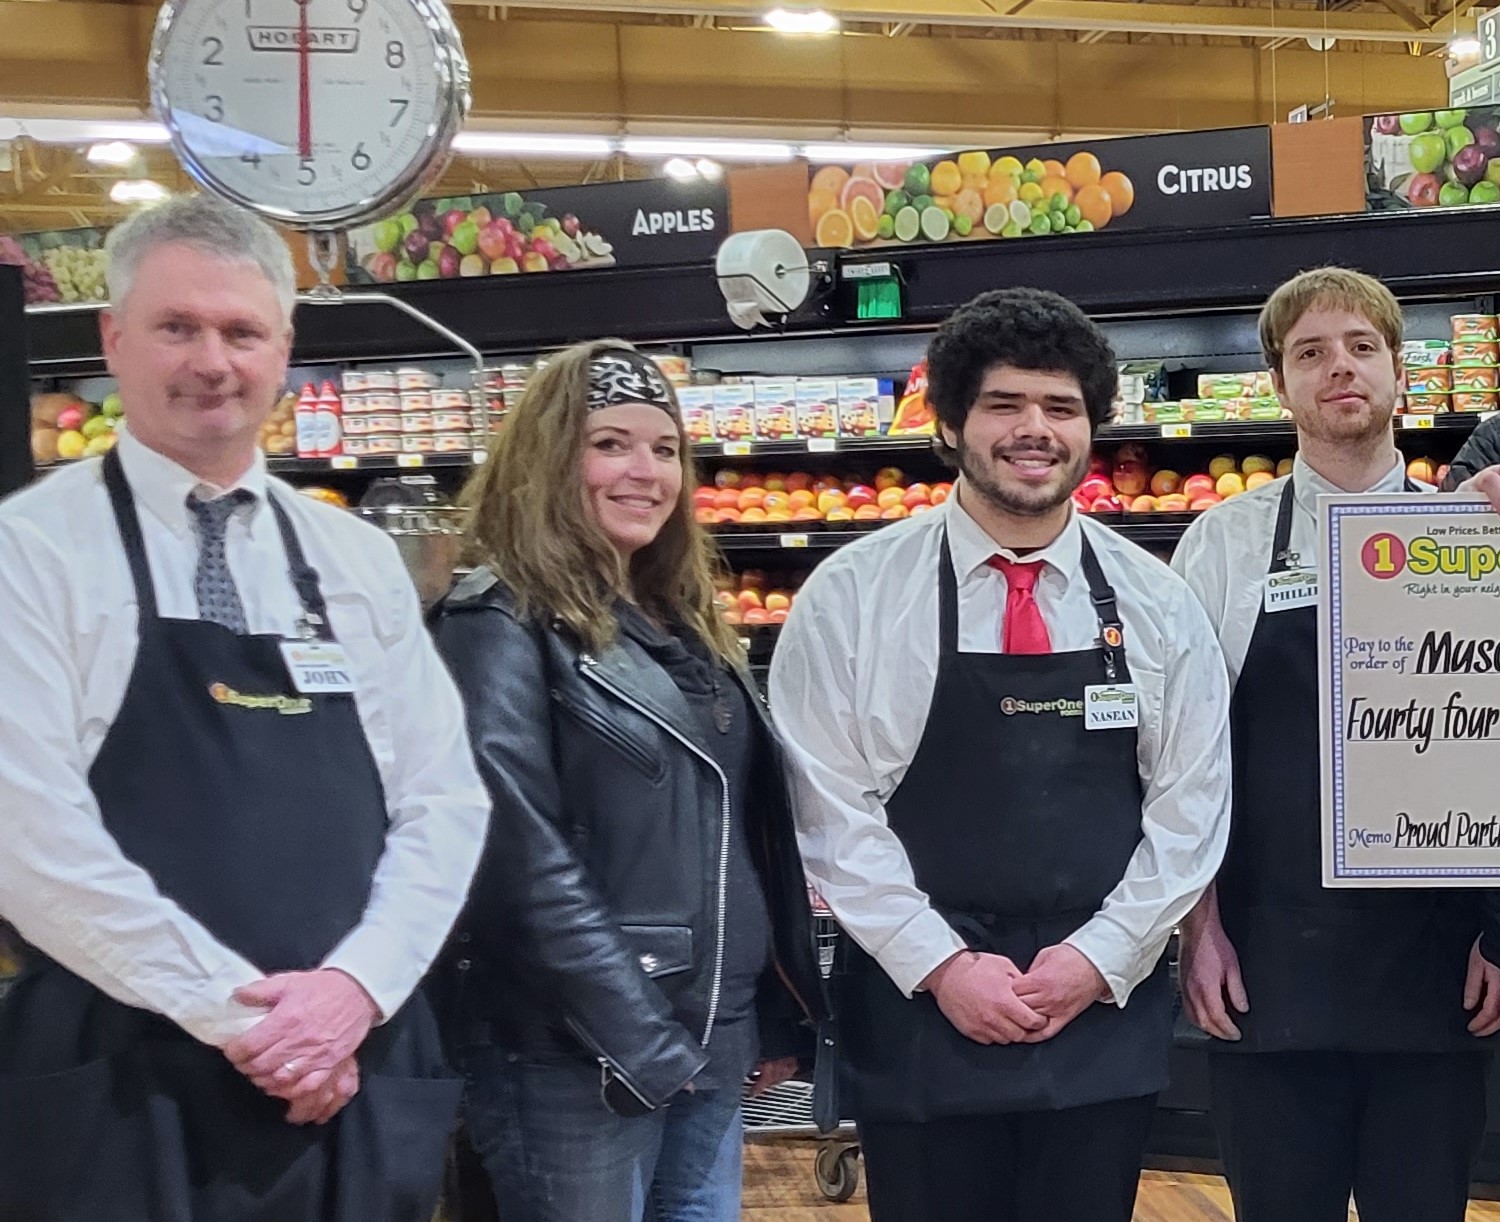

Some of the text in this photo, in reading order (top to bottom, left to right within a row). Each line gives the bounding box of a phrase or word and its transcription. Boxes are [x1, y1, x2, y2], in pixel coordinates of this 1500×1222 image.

[202, 36, 224, 65] 2
[258, 31, 350, 45] HOBART
[1484, 18, 1496, 60] 3
[385, 40, 406, 69] 8
[204, 95, 225, 122] 3
[389, 99, 409, 127] 7
[240, 146, 261, 169] 4
[351, 142, 371, 170] 6
[297, 158, 316, 186] 5
[1158, 164, 1252, 195] CITRUS
[632, 208, 715, 237] APPLES
[1426, 526, 1446, 536] Low
[1448, 525, 1480, 535] Prices.
[1402, 582, 1438, 598] Right
[1440, 583, 1451, 594] in
[1453, 585, 1478, 598] your
[1344, 636, 1414, 660] Pay to the
[1350, 656, 1411, 674] order of
[1016, 698, 1084, 714] SuperOne
[1091, 709, 1136, 723] NASEAN
[1347, 697, 1435, 754] Fourty
[1442, 691, 1500, 740] four
[1348, 828, 1392, 849] Memo
[1394, 810, 1453, 848] Proud
